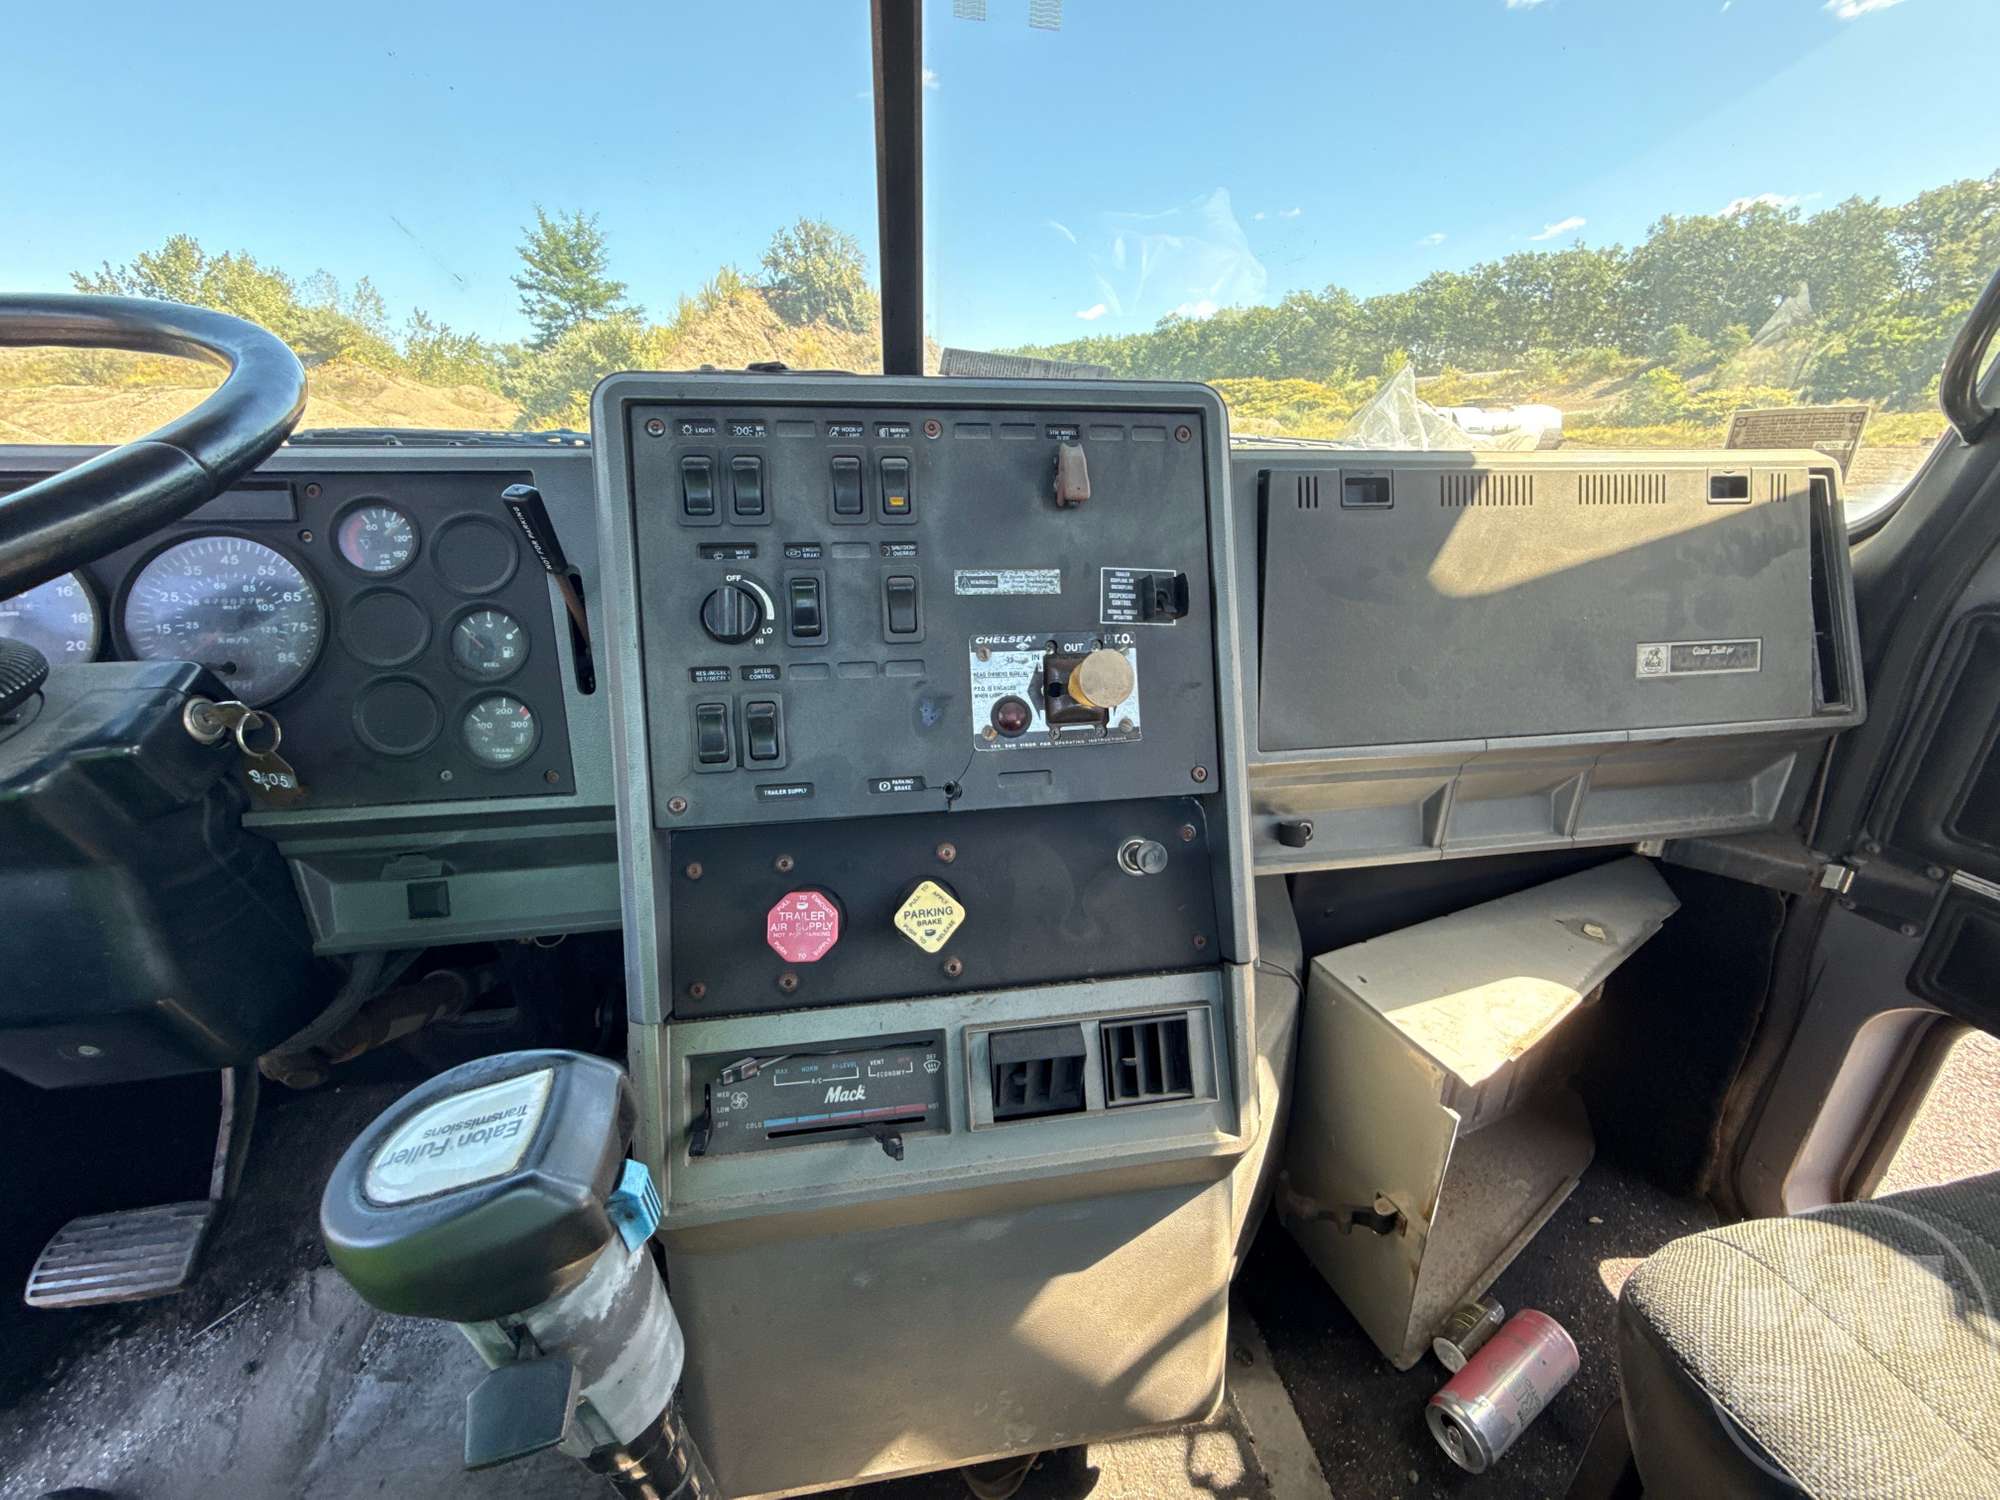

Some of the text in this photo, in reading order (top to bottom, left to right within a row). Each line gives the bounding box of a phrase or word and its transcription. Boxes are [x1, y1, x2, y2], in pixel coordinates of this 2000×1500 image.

[513, 506, 552, 570] NOT FOR PARKING
[726, 574, 741, 582] OFF
[155, 555, 309, 663] 15 25 35 45 55 65 75 85
[56, 586, 73, 597] 16
[66, 640, 87, 651] 20
[186, 622, 199, 630] 25
[257, 604, 275, 612] 105
[762, 627, 773, 635] LO
[975, 635, 1033, 644] CHELSEA
[1064, 643, 1084, 652] OUT
[779, 911, 825, 921] TRAILER
[904, 906, 953, 920] PARKING
[770, 922, 833, 932] AIR SUPPLY
[917, 918, 943, 927] BRAKE
[870, 1058, 884, 1066] VENT
[801, 1065, 819, 1073] NORM
[876, 1069, 905, 1078] ECONOMY
[824, 1084, 866, 1104] Mack
[424, 1104, 528, 1139] Transmissions
[380, 1118, 523, 1167] Eaton Fuller
